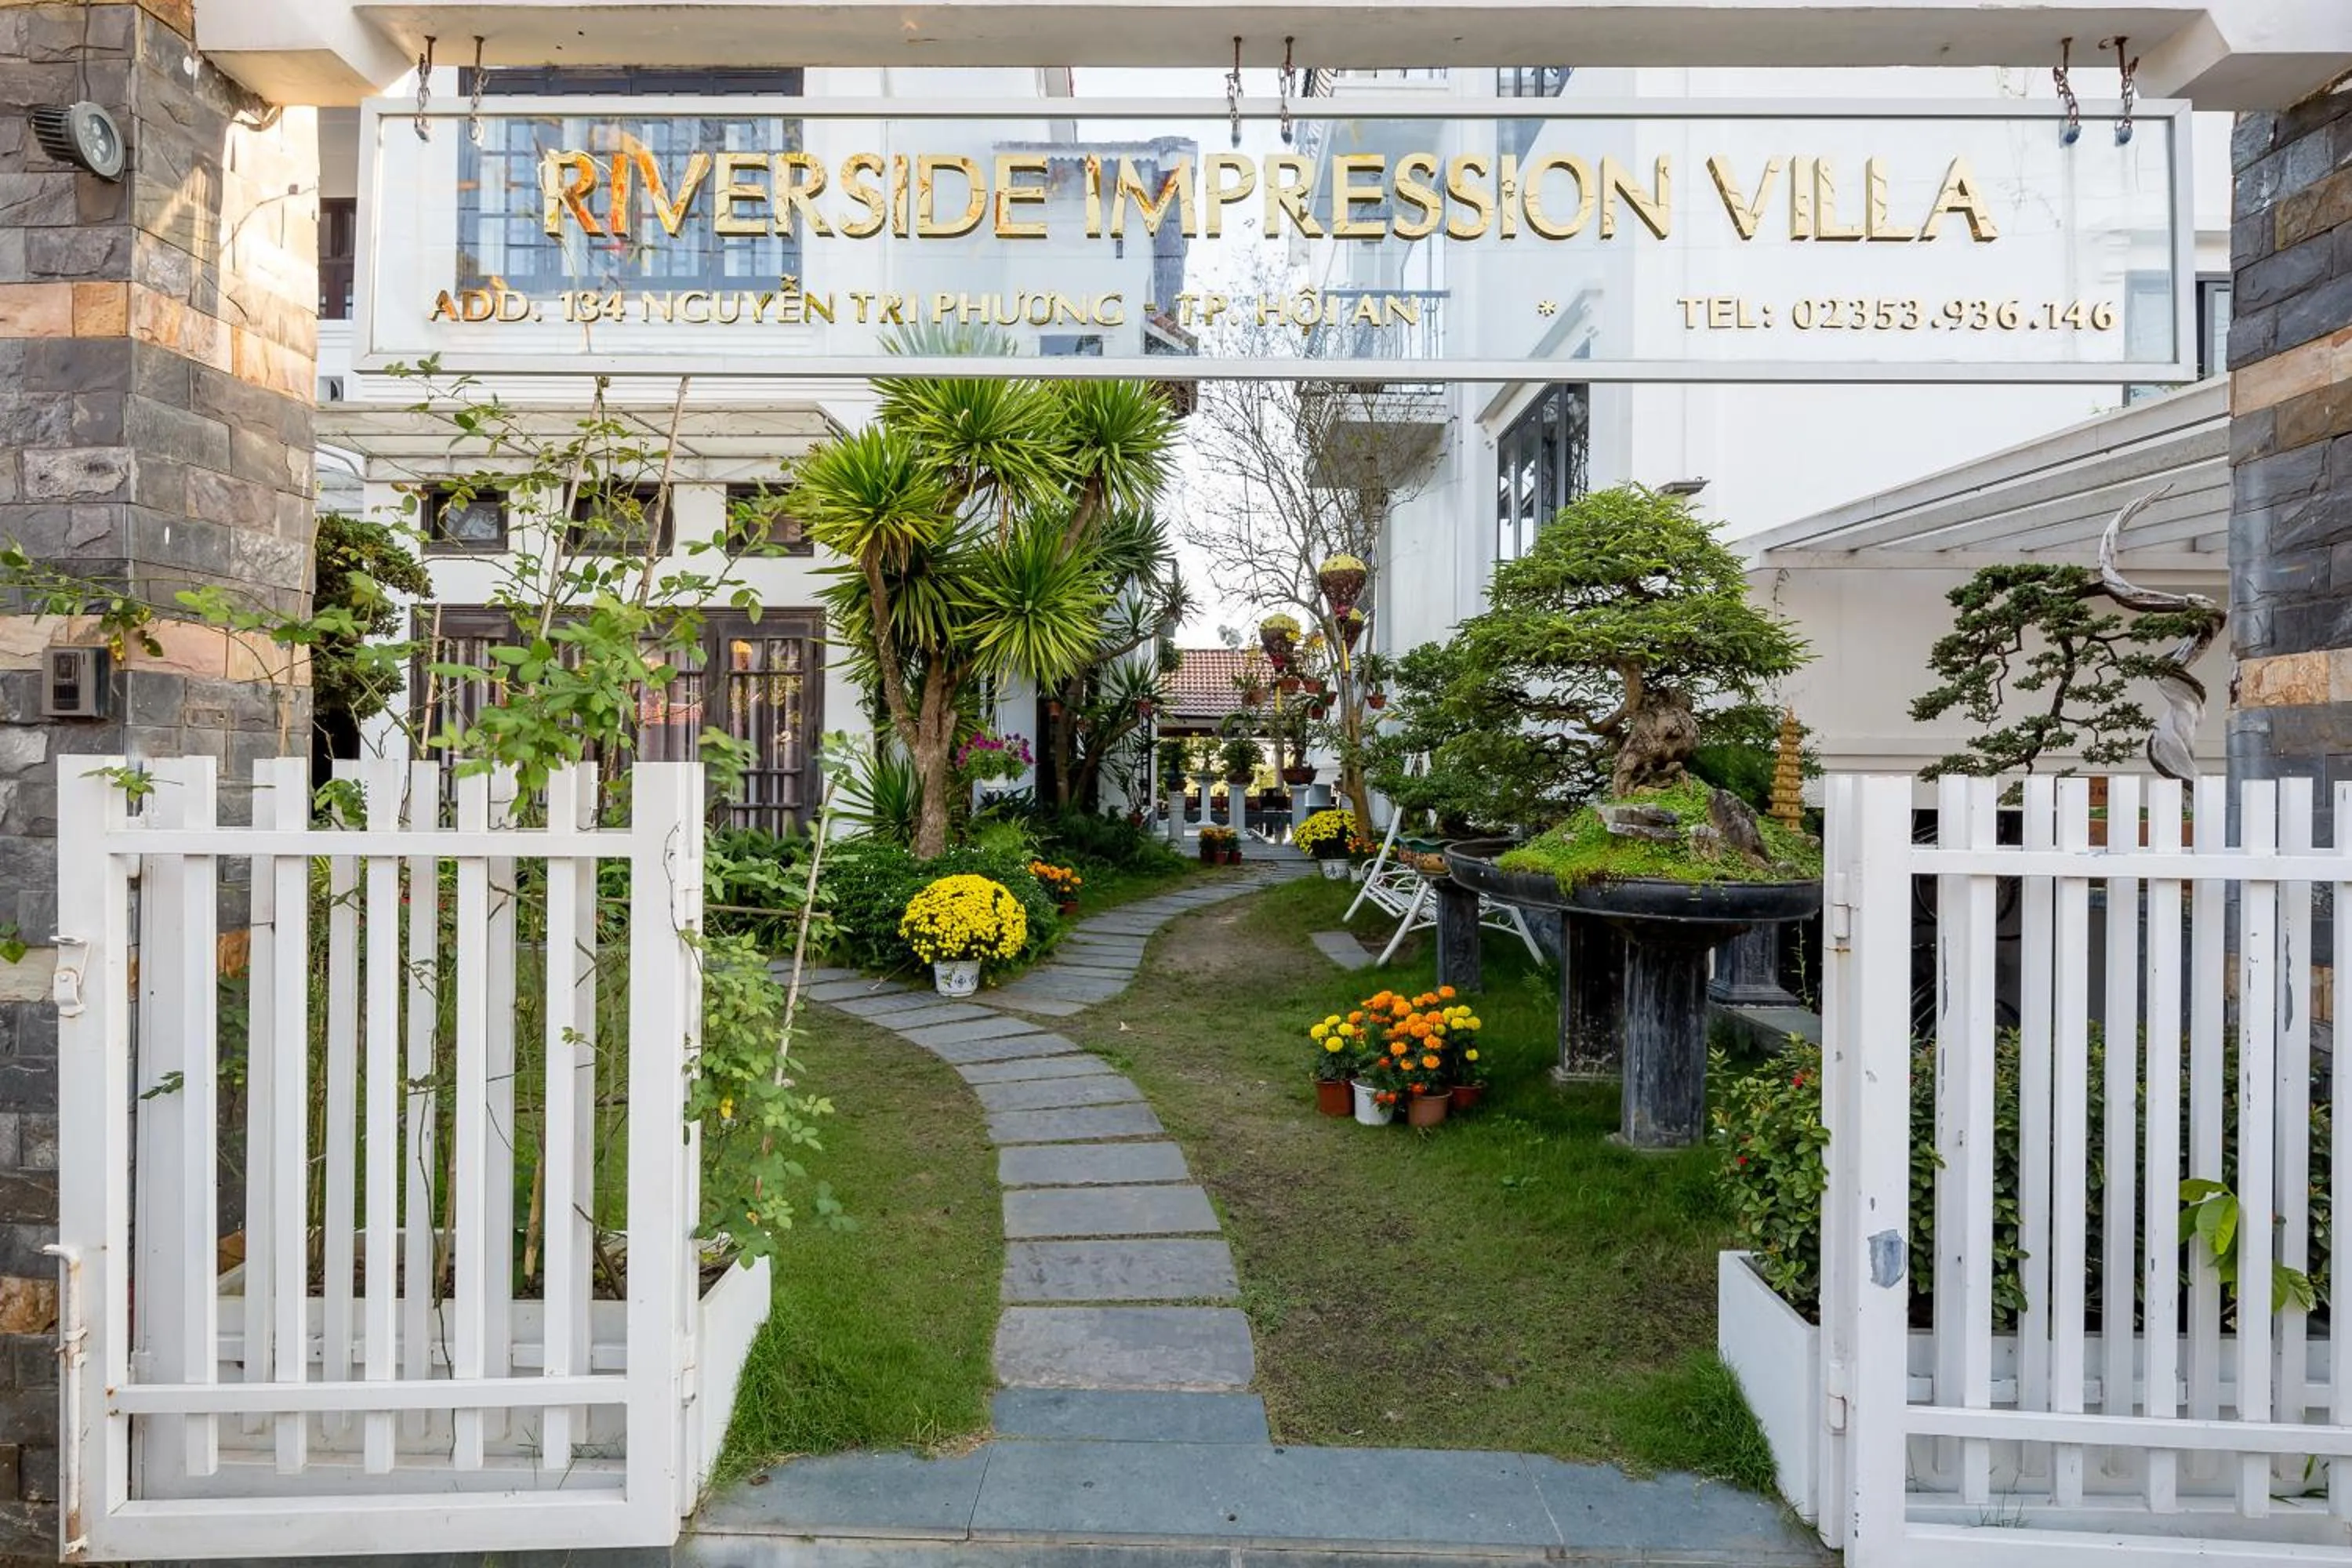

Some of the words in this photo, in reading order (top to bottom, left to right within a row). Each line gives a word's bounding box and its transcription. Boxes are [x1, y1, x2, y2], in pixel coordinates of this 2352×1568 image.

[543, 151, 1047, 238] RIVERSIDE
[1084, 151, 1671, 241] IMPRESSION
[1706, 156, 1998, 242] VILLA
[560, 289, 626, 322] 134
[849, 291, 917, 325] TRI
[931, 288, 1123, 326] PHƯƠNG
[1175, 294, 1238, 326] TP.
[1256, 284, 1340, 336] HỘI
[1351, 293, 1420, 327] AN
[1676, 296, 1773, 329] TEL:
[1792, 299, 2116, 330] 02353.936.146
